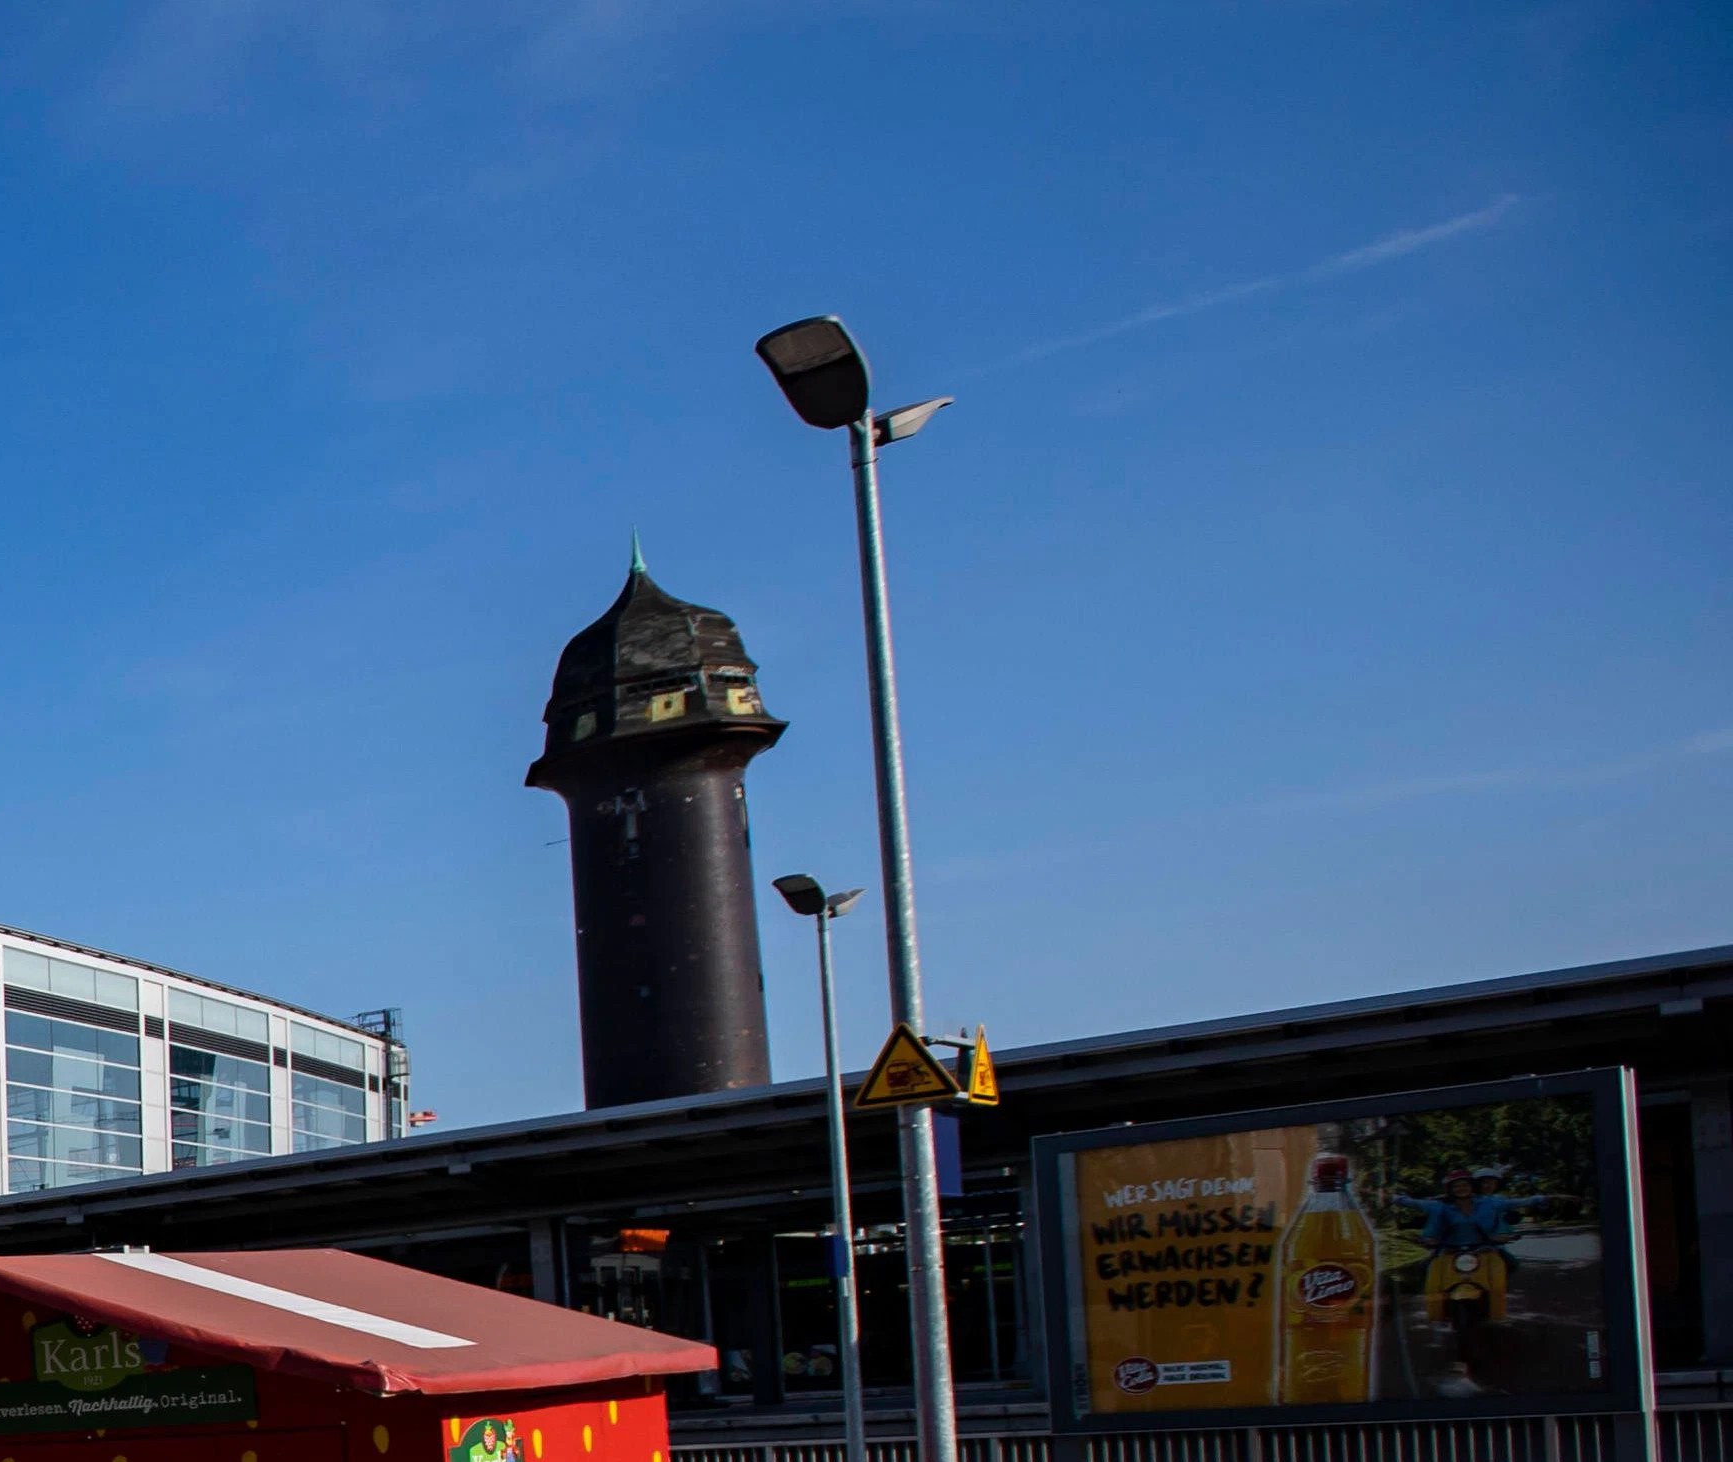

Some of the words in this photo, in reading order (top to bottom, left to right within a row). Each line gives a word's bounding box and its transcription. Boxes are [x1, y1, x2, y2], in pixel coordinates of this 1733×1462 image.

[1104, 1184, 1148, 1208] WER
[1149, 1177, 1197, 1202] SAGT
[1092, 1214, 1153, 1246] WIR
[1158, 1202, 1277, 1238] MÜSSEN
[1095, 1243, 1273, 1280] ERWACHSEN
[40, 1331, 141, 1376] Karls
[160, 1389, 242, 1409] Original.
